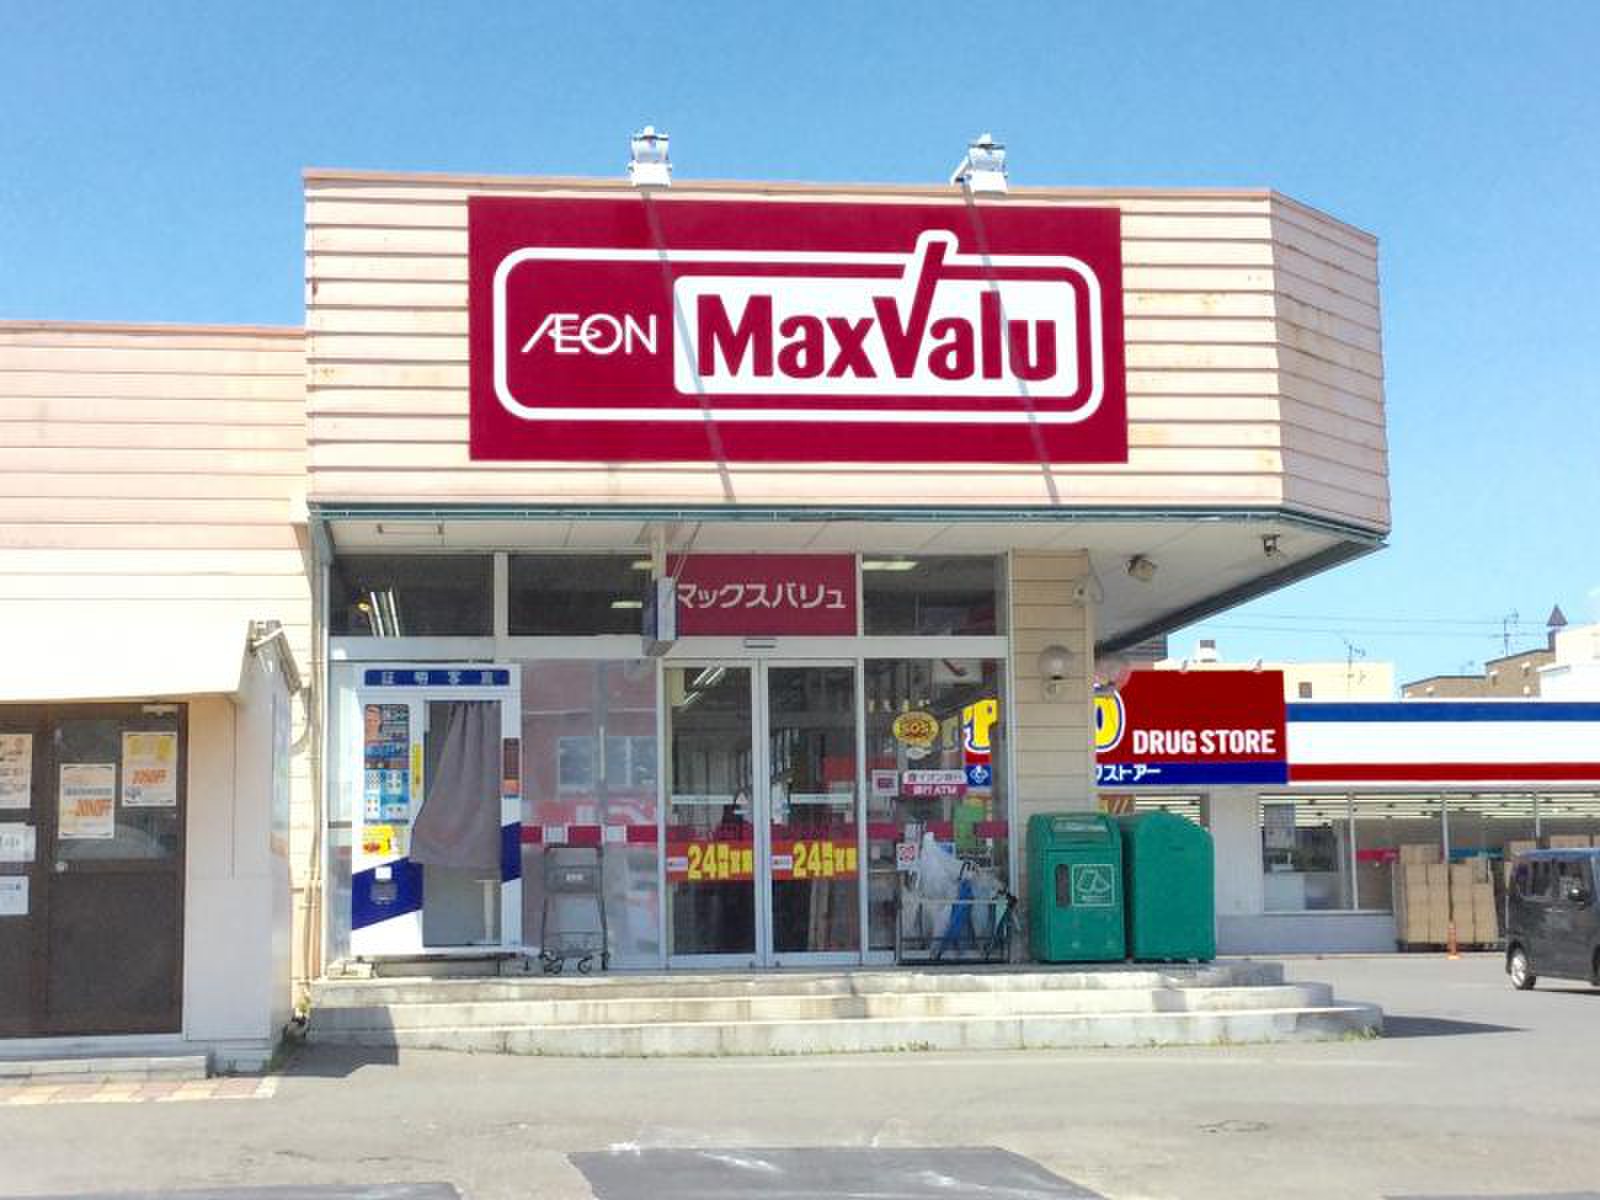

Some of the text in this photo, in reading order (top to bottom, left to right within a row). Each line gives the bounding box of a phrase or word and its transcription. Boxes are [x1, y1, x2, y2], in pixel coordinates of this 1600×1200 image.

[696, 240, 1057, 382] MaxValu
[677, 582, 847, 608] マックスバリュ
[1132, 728, 1277, 755] DRUG STORE
